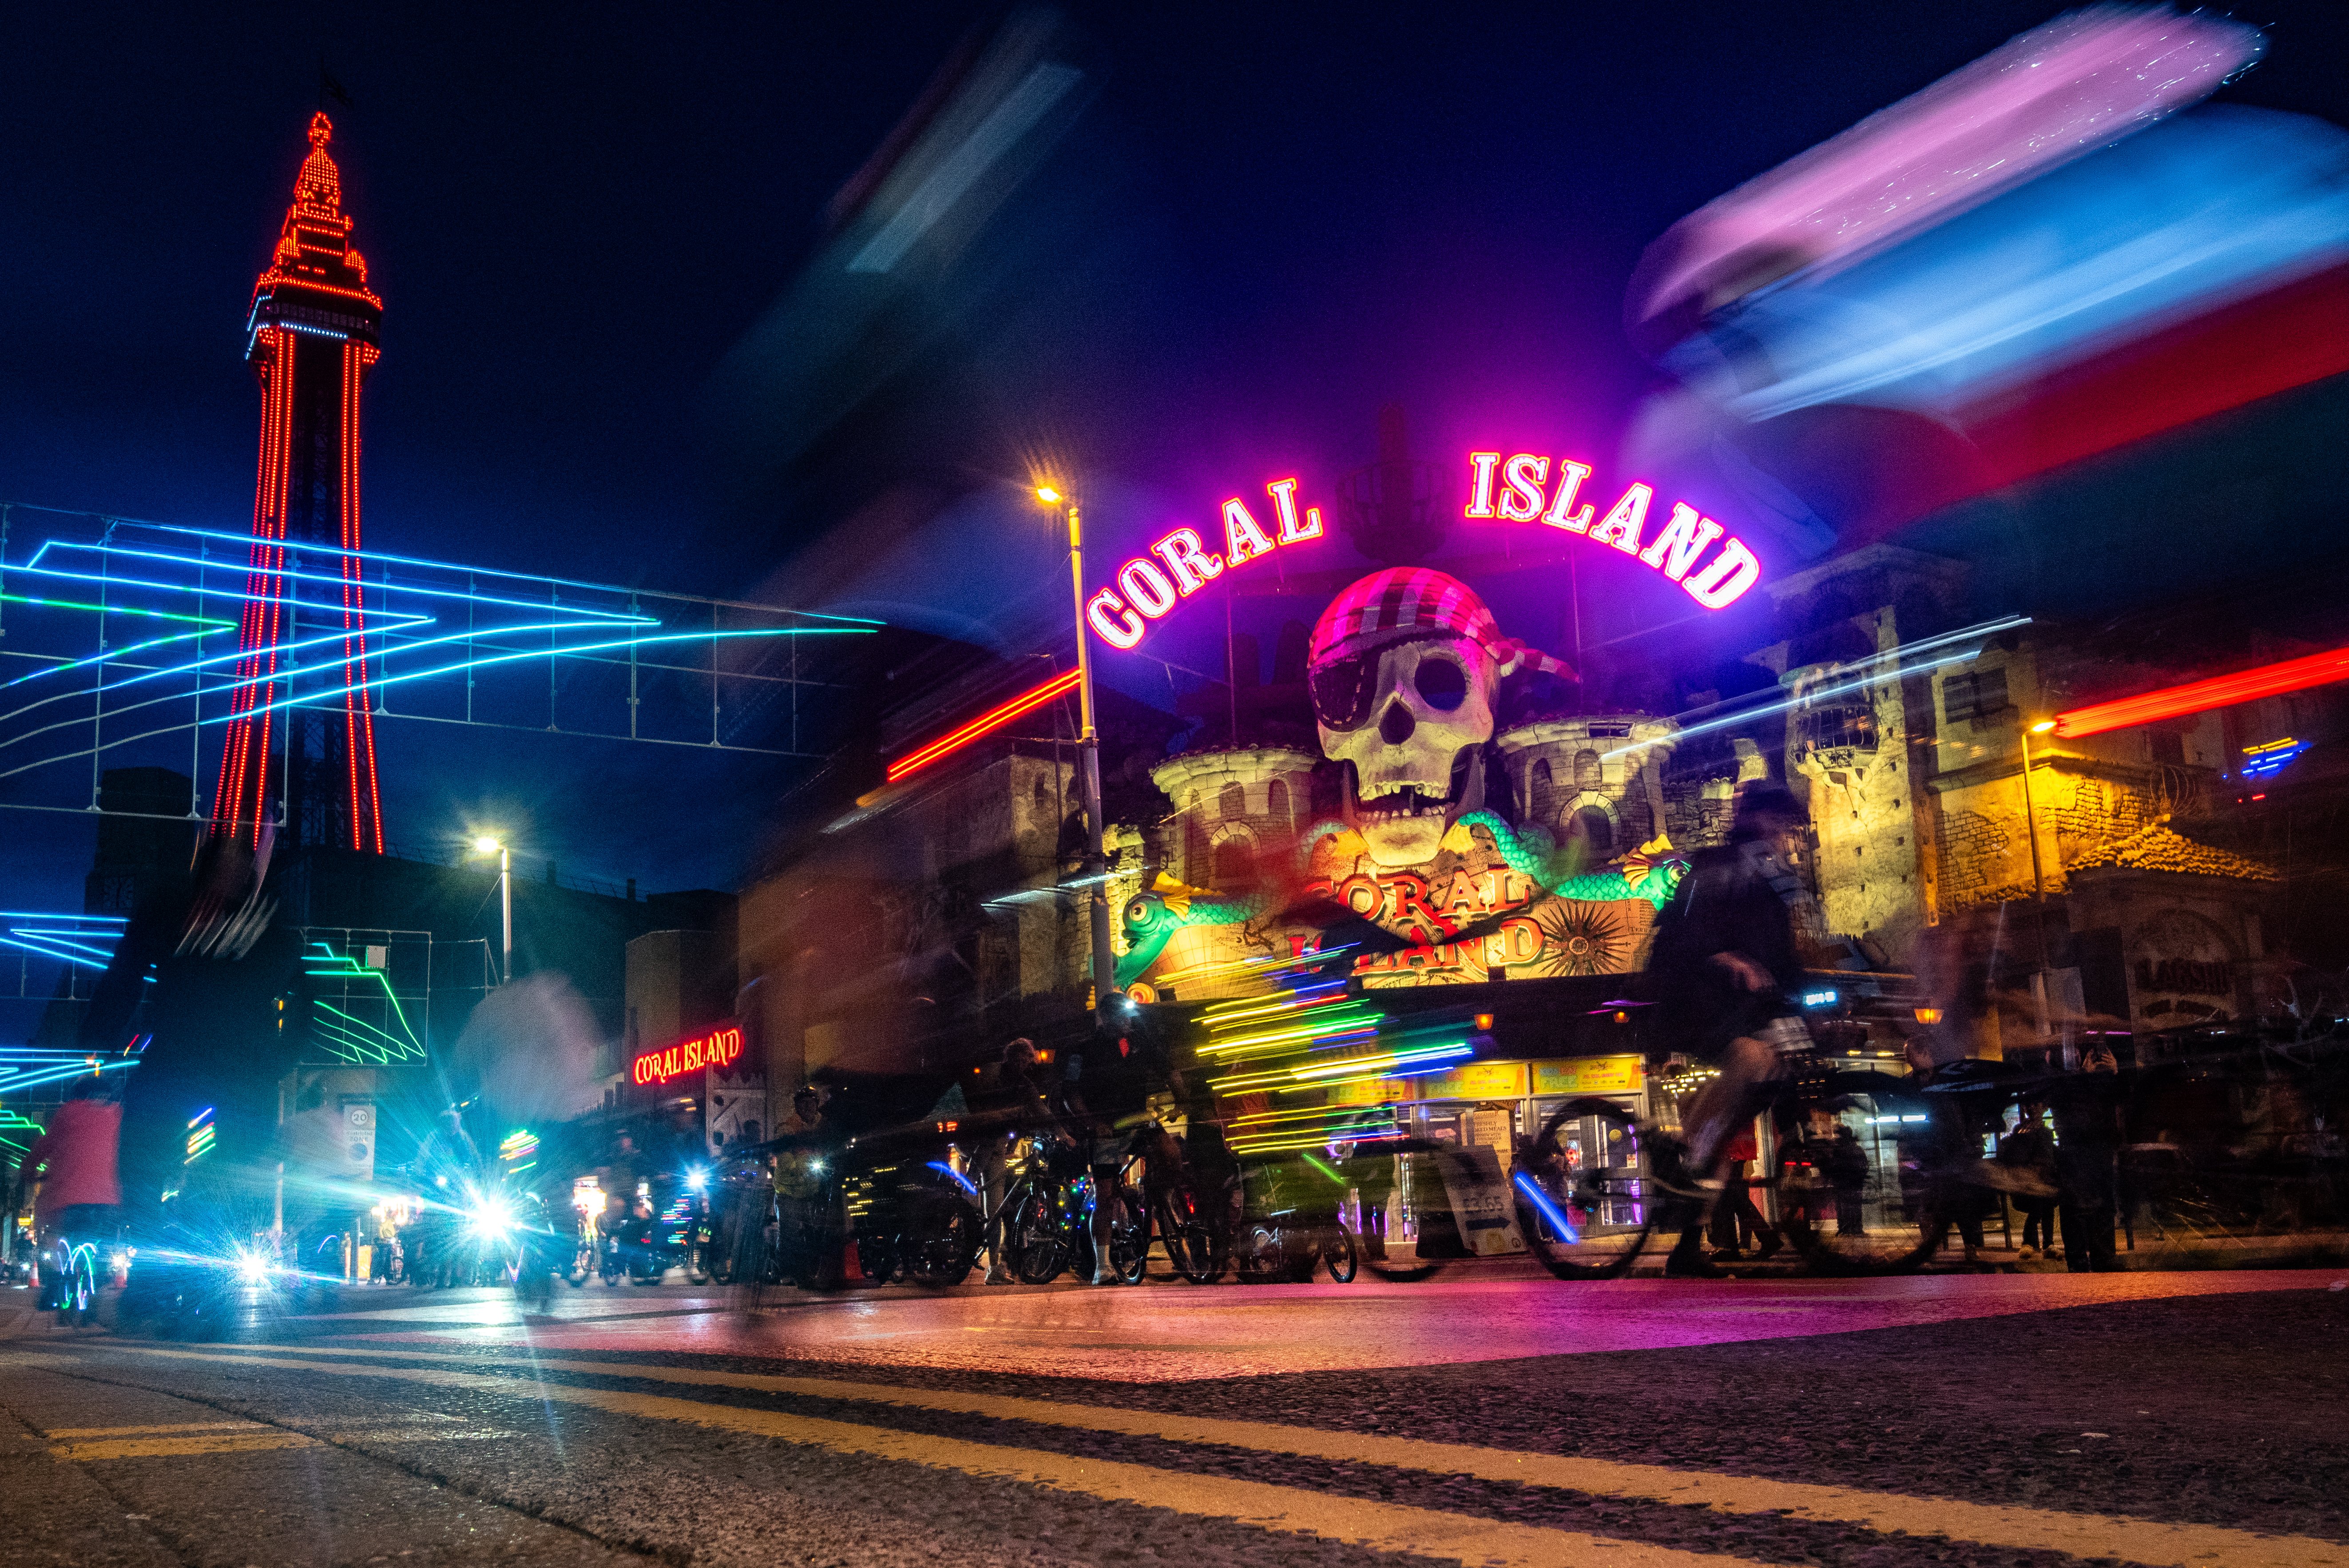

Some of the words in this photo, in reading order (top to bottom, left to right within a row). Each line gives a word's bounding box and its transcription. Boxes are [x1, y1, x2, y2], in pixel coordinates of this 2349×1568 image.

[1087, 477, 1323, 649] CORAL
[1464, 452, 1760, 609] ISLAND
[1288, 918, 1546, 976] ILAND
[635, 1048, 681, 1084] CORAL
[683, 1028, 740, 1071] ISLAND
